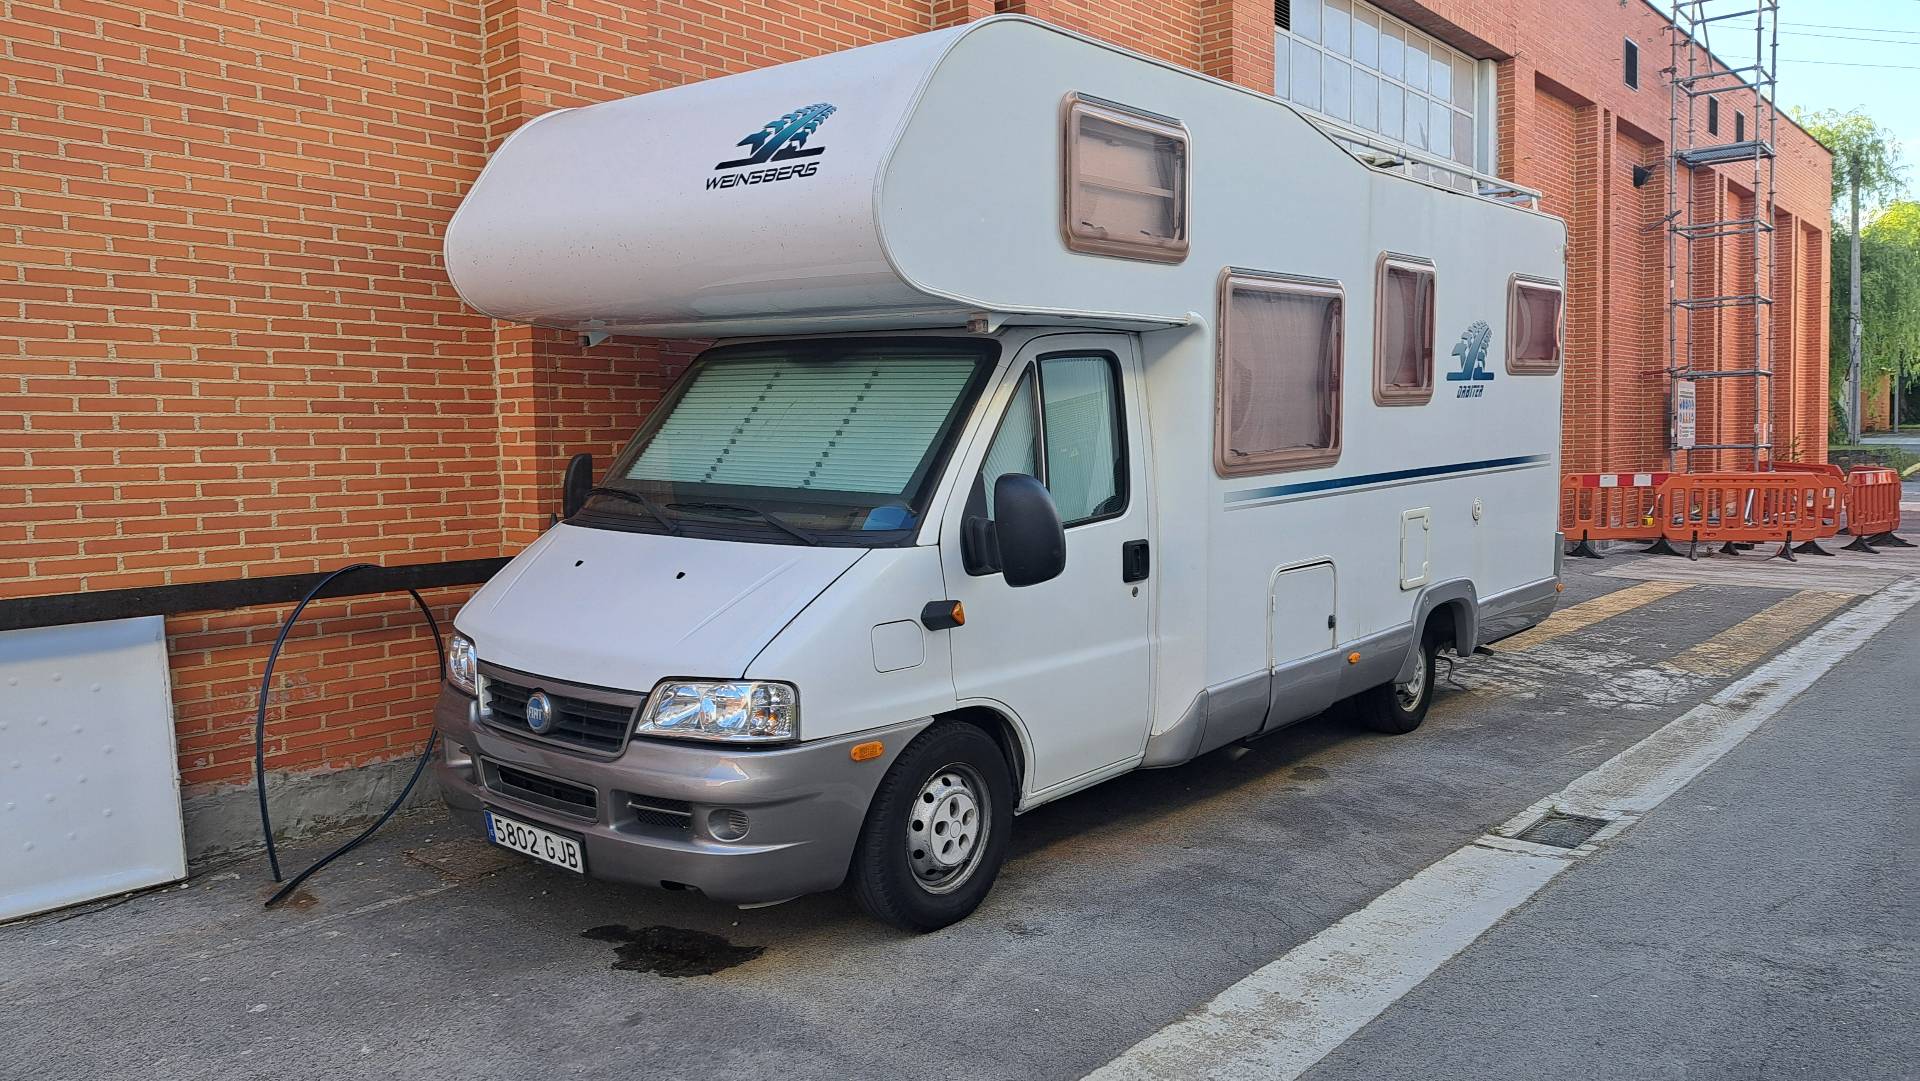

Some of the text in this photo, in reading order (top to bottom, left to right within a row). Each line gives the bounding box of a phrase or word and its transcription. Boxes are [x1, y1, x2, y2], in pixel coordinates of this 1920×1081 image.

[705, 161, 820, 191] WEINSBERG
[1456, 385, 1484, 399] ORBITER
[528, 706, 543, 720] FIAT
[495, 818, 578, 868] 5802 GJB
